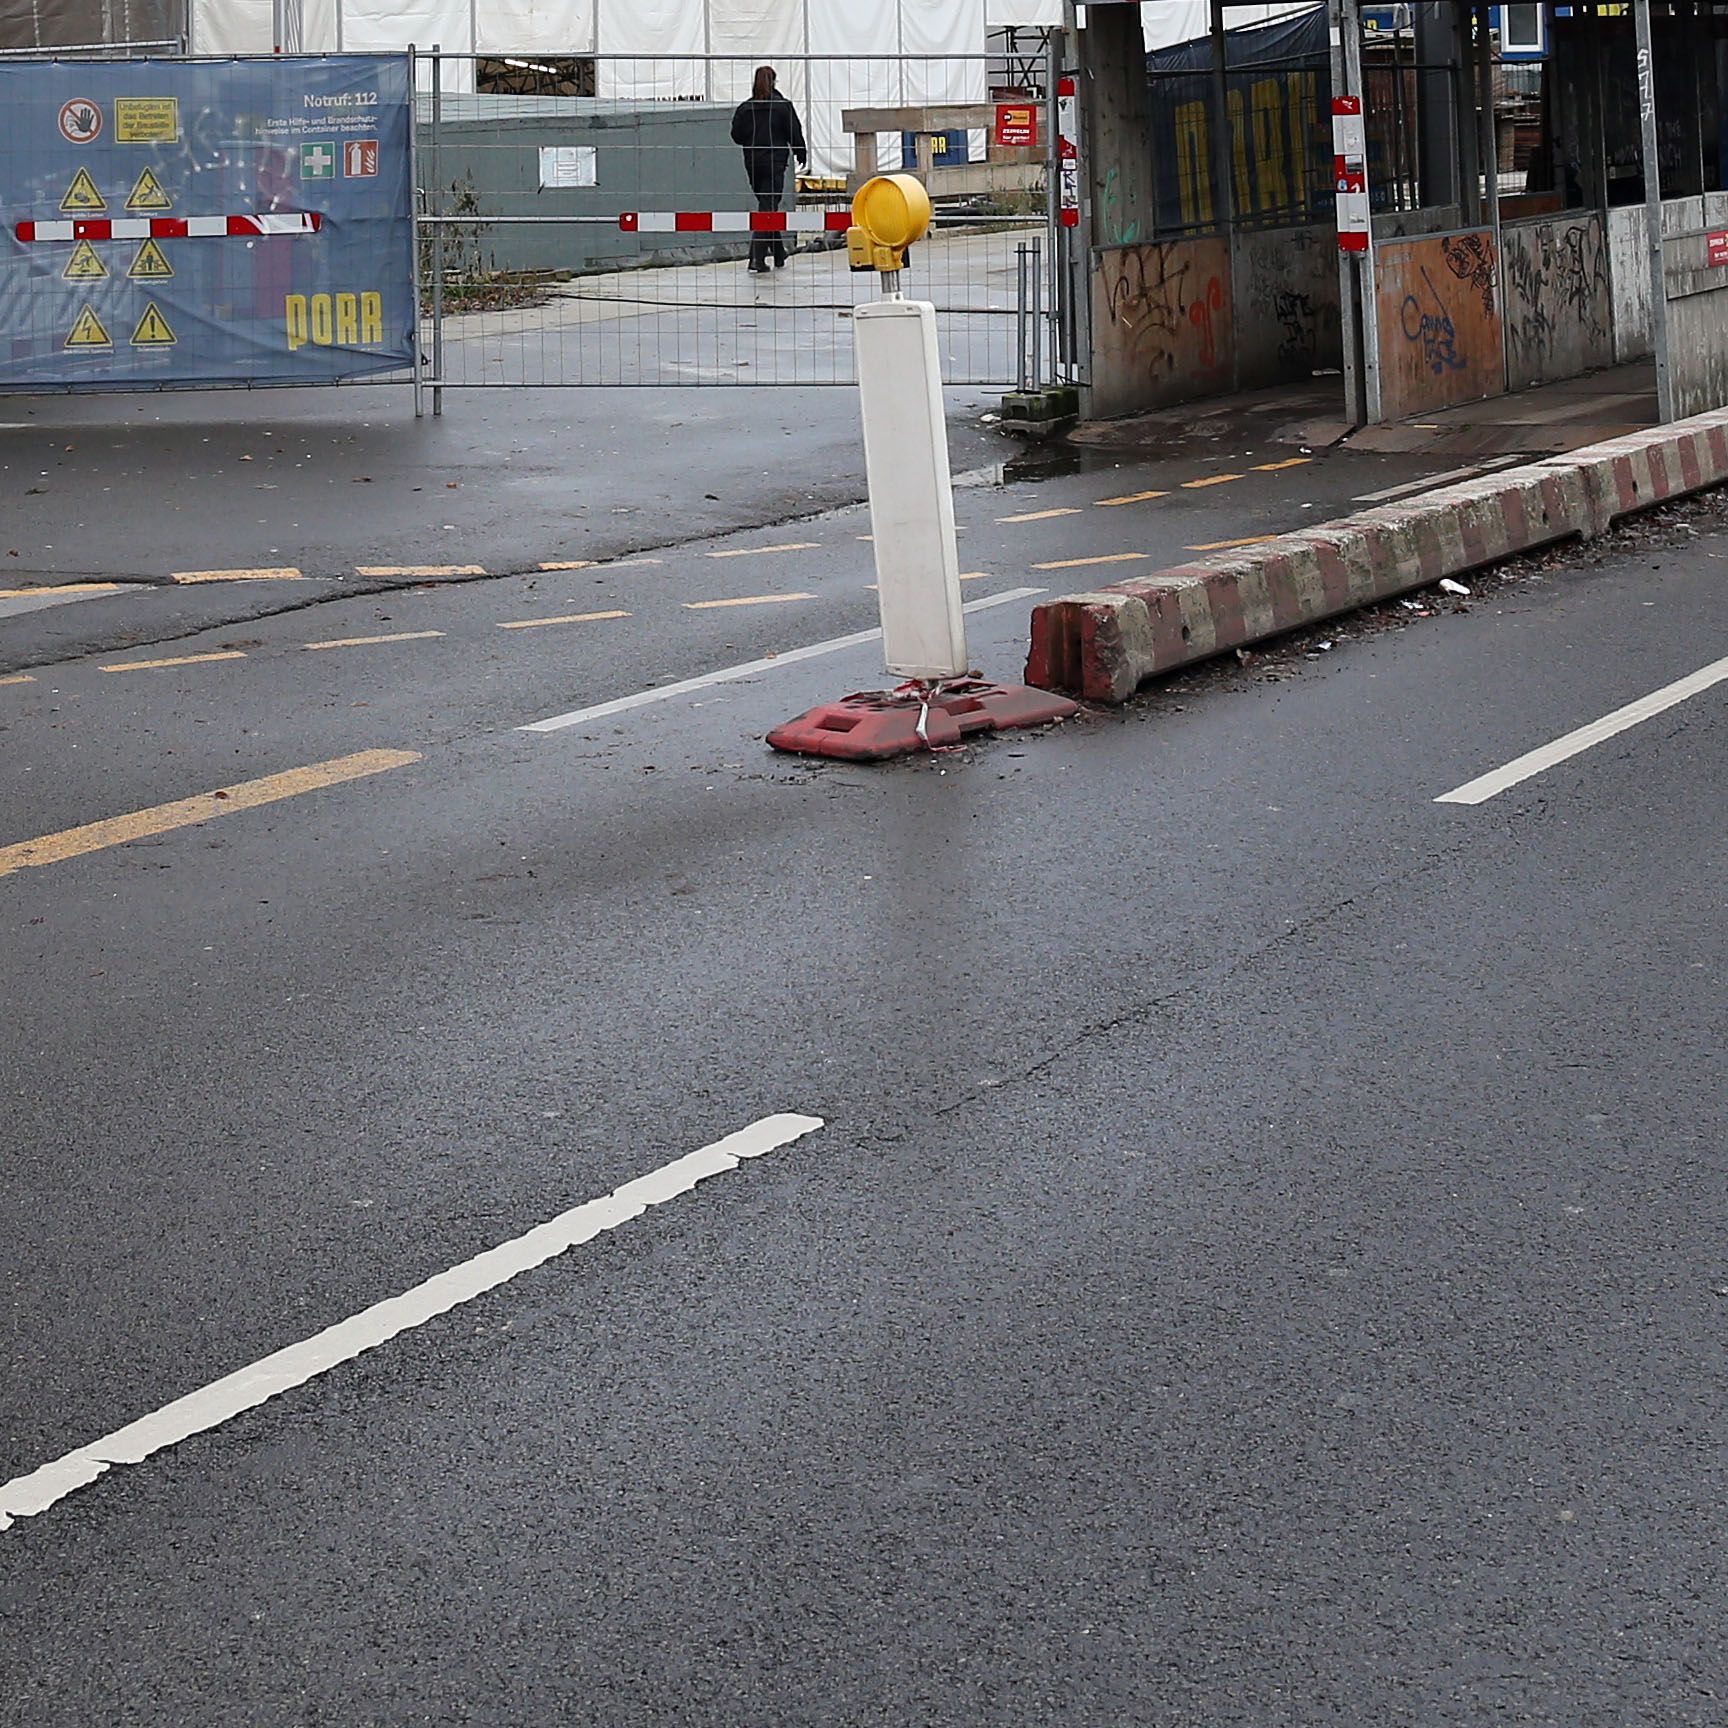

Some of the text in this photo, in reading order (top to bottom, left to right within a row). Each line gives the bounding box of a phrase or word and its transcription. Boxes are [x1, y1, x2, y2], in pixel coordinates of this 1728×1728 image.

[303, 92, 378, 108] Notruf: 112
[267, 118, 288, 127] Erste
[311, 116, 327, 125] und
[302, 125, 339, 134] Container
[284, 291, 383, 351] PORR
